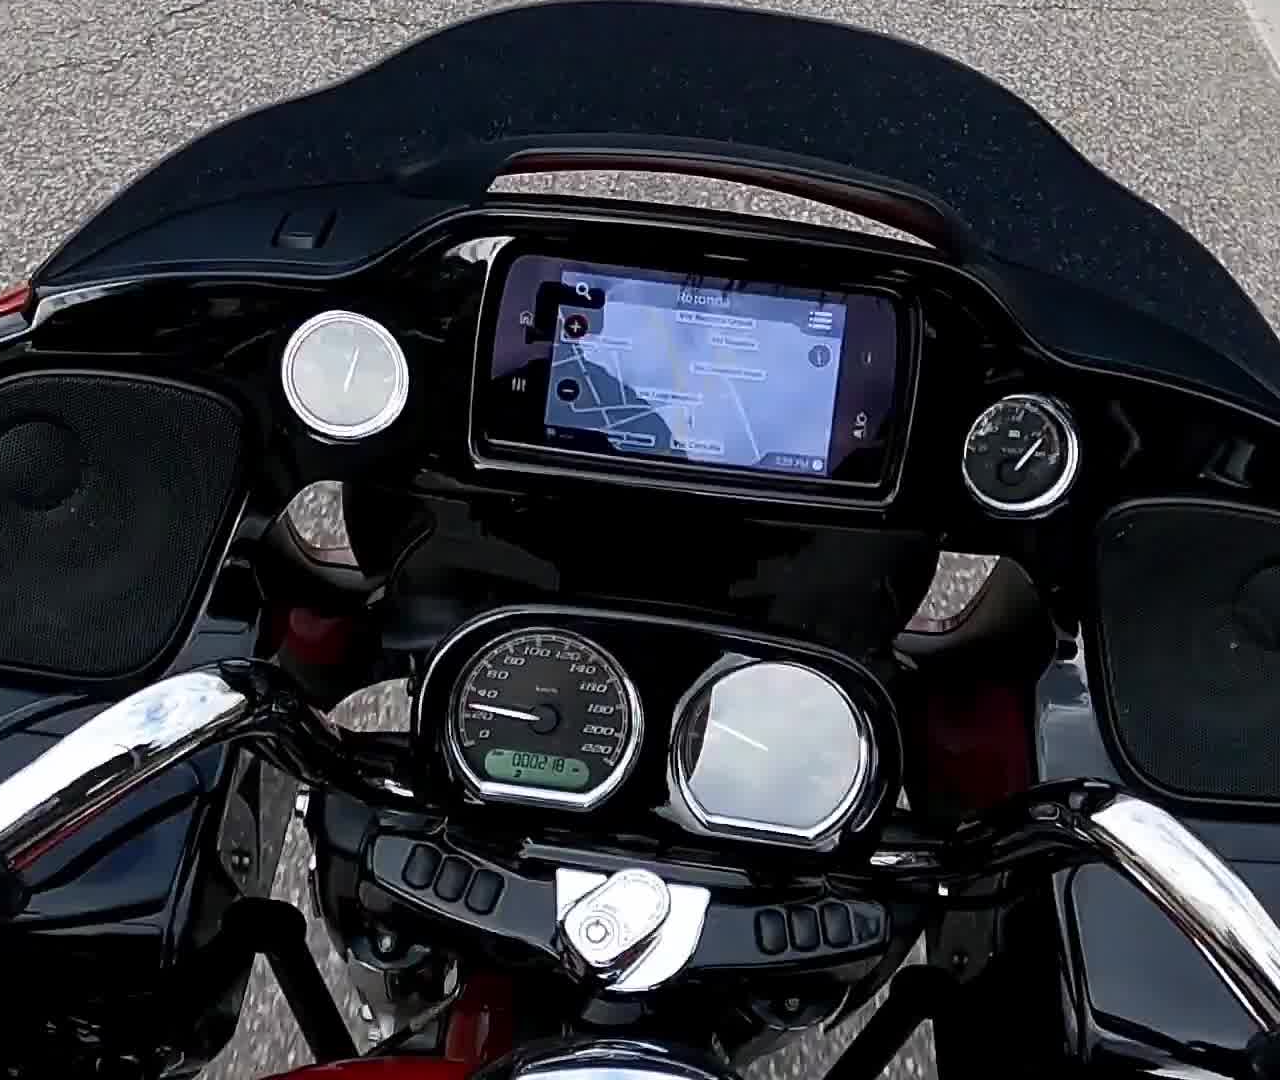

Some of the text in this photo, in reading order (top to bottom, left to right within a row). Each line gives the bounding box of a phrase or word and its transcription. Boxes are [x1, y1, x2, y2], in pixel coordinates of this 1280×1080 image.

[523, 646, 551, 657] 100
[555, 650, 581, 662] 120
[503, 656, 526, 666] 80
[569, 664, 596, 674] 140
[487, 670, 510, 680] 60
[478, 689, 498, 699] 40
[587, 703, 615, 715] 180
[472, 711, 493, 721] 20
[479, 729, 490, 739] 0
[583, 724, 615, 736] 200
[581, 743, 613, 754] 220
